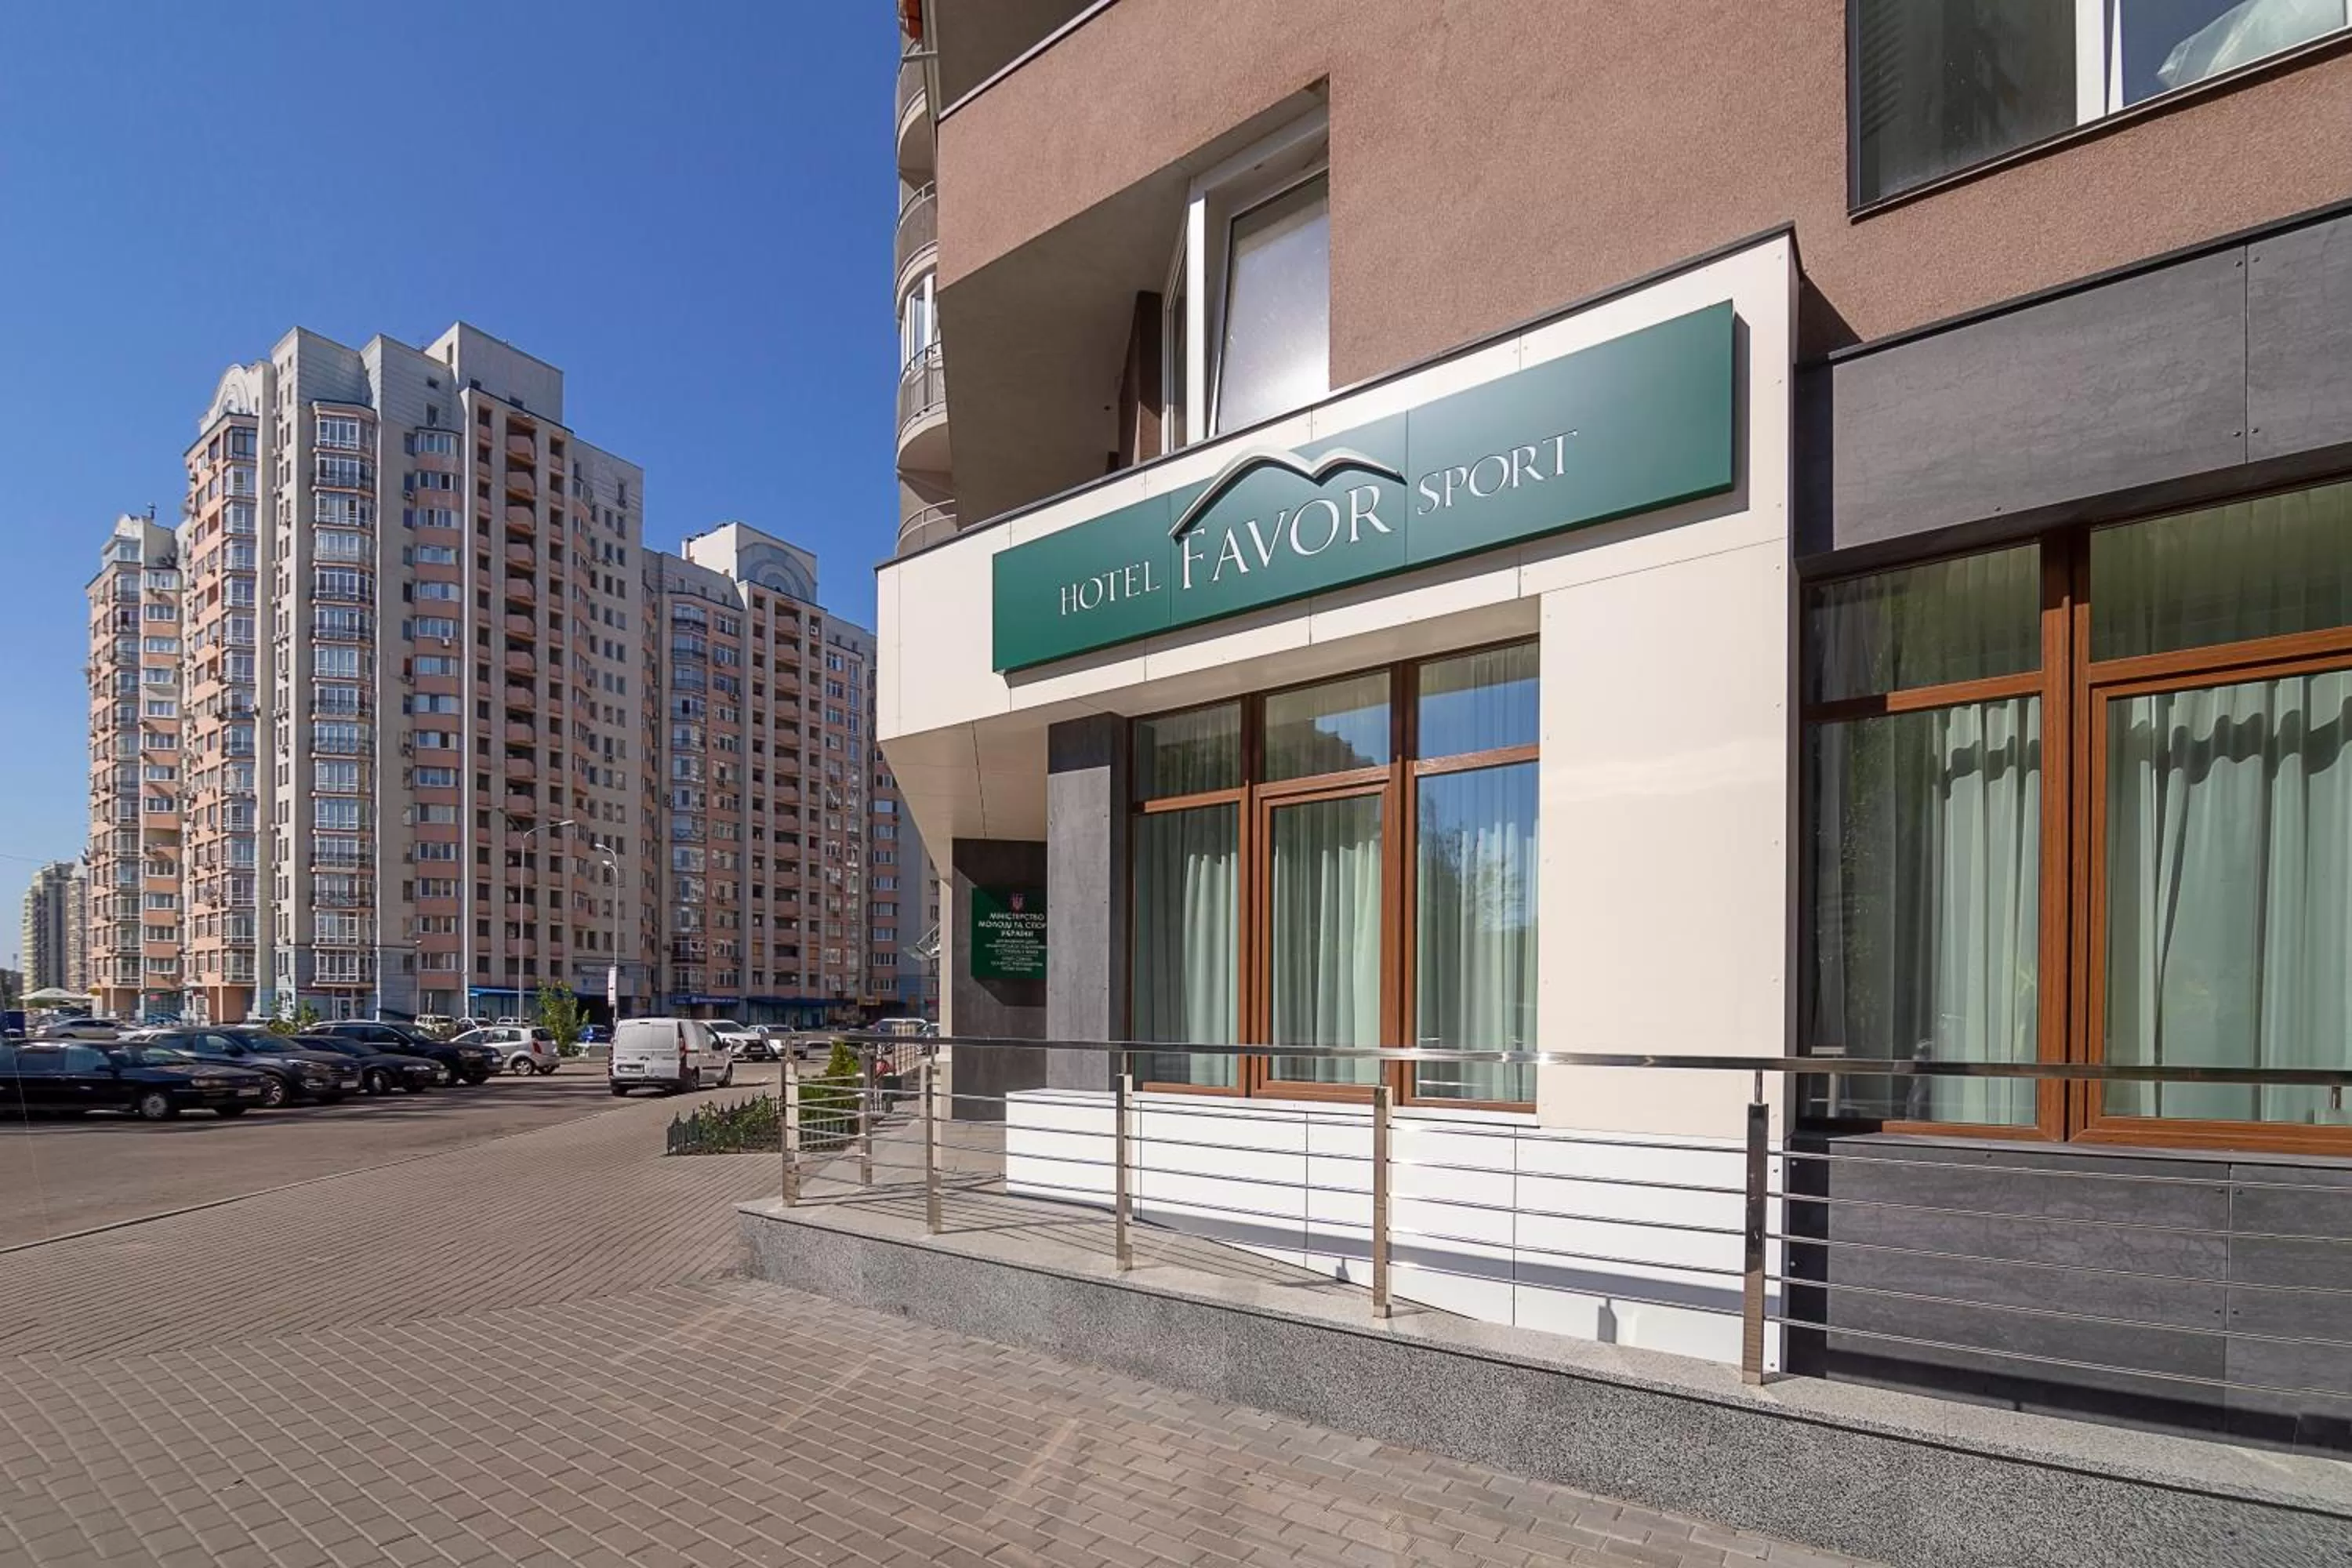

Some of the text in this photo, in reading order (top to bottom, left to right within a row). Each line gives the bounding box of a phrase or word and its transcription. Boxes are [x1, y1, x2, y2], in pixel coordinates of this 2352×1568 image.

[1060, 430, 1578, 615] HOTEL FAVOR SPORT
